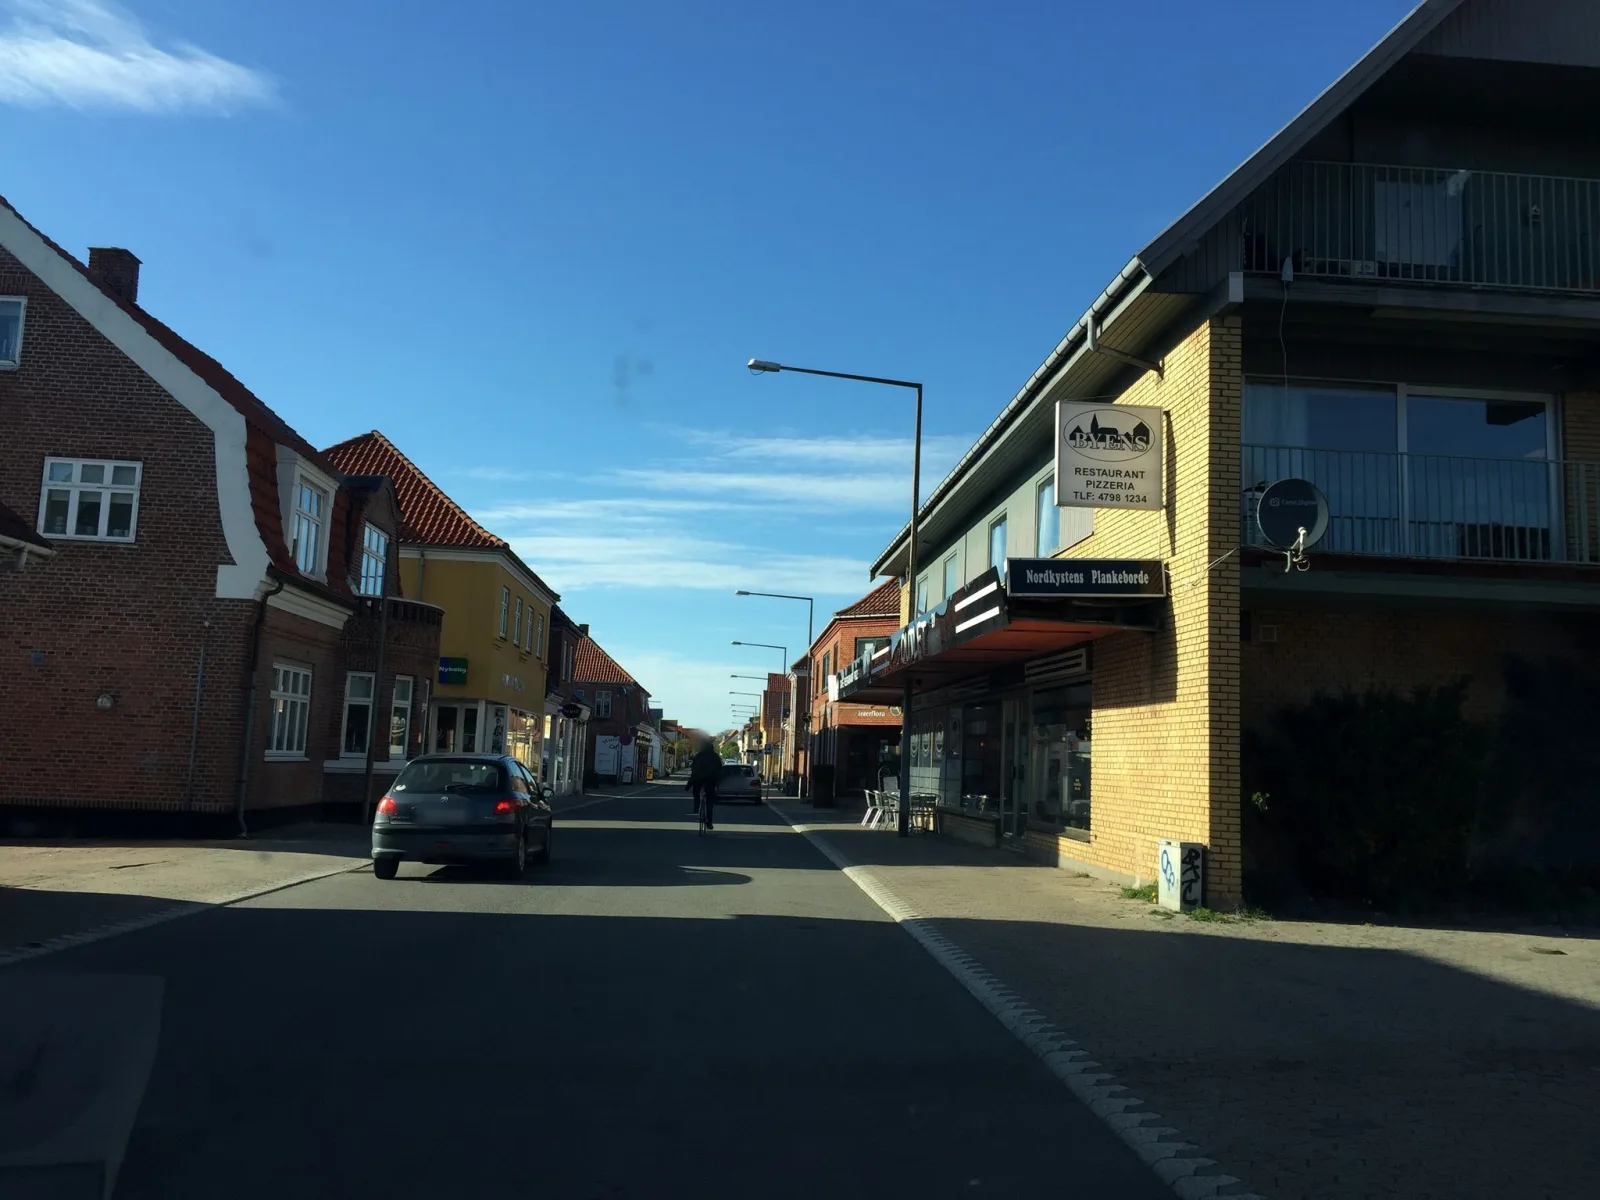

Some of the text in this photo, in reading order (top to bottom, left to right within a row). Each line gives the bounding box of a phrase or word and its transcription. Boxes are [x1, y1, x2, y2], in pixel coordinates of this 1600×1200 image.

[1073, 432, 1148, 452] BYENS
[1074, 467, 1146, 480] RESTAURANT
[1085, 479, 1136, 491] PIZZERIA
[1073, 491, 1148, 503] TLF: 4798 1234
[1025, 568, 1149, 587] Nordkystens Plankeborde
[438, 666, 467, 674] Nybolig
